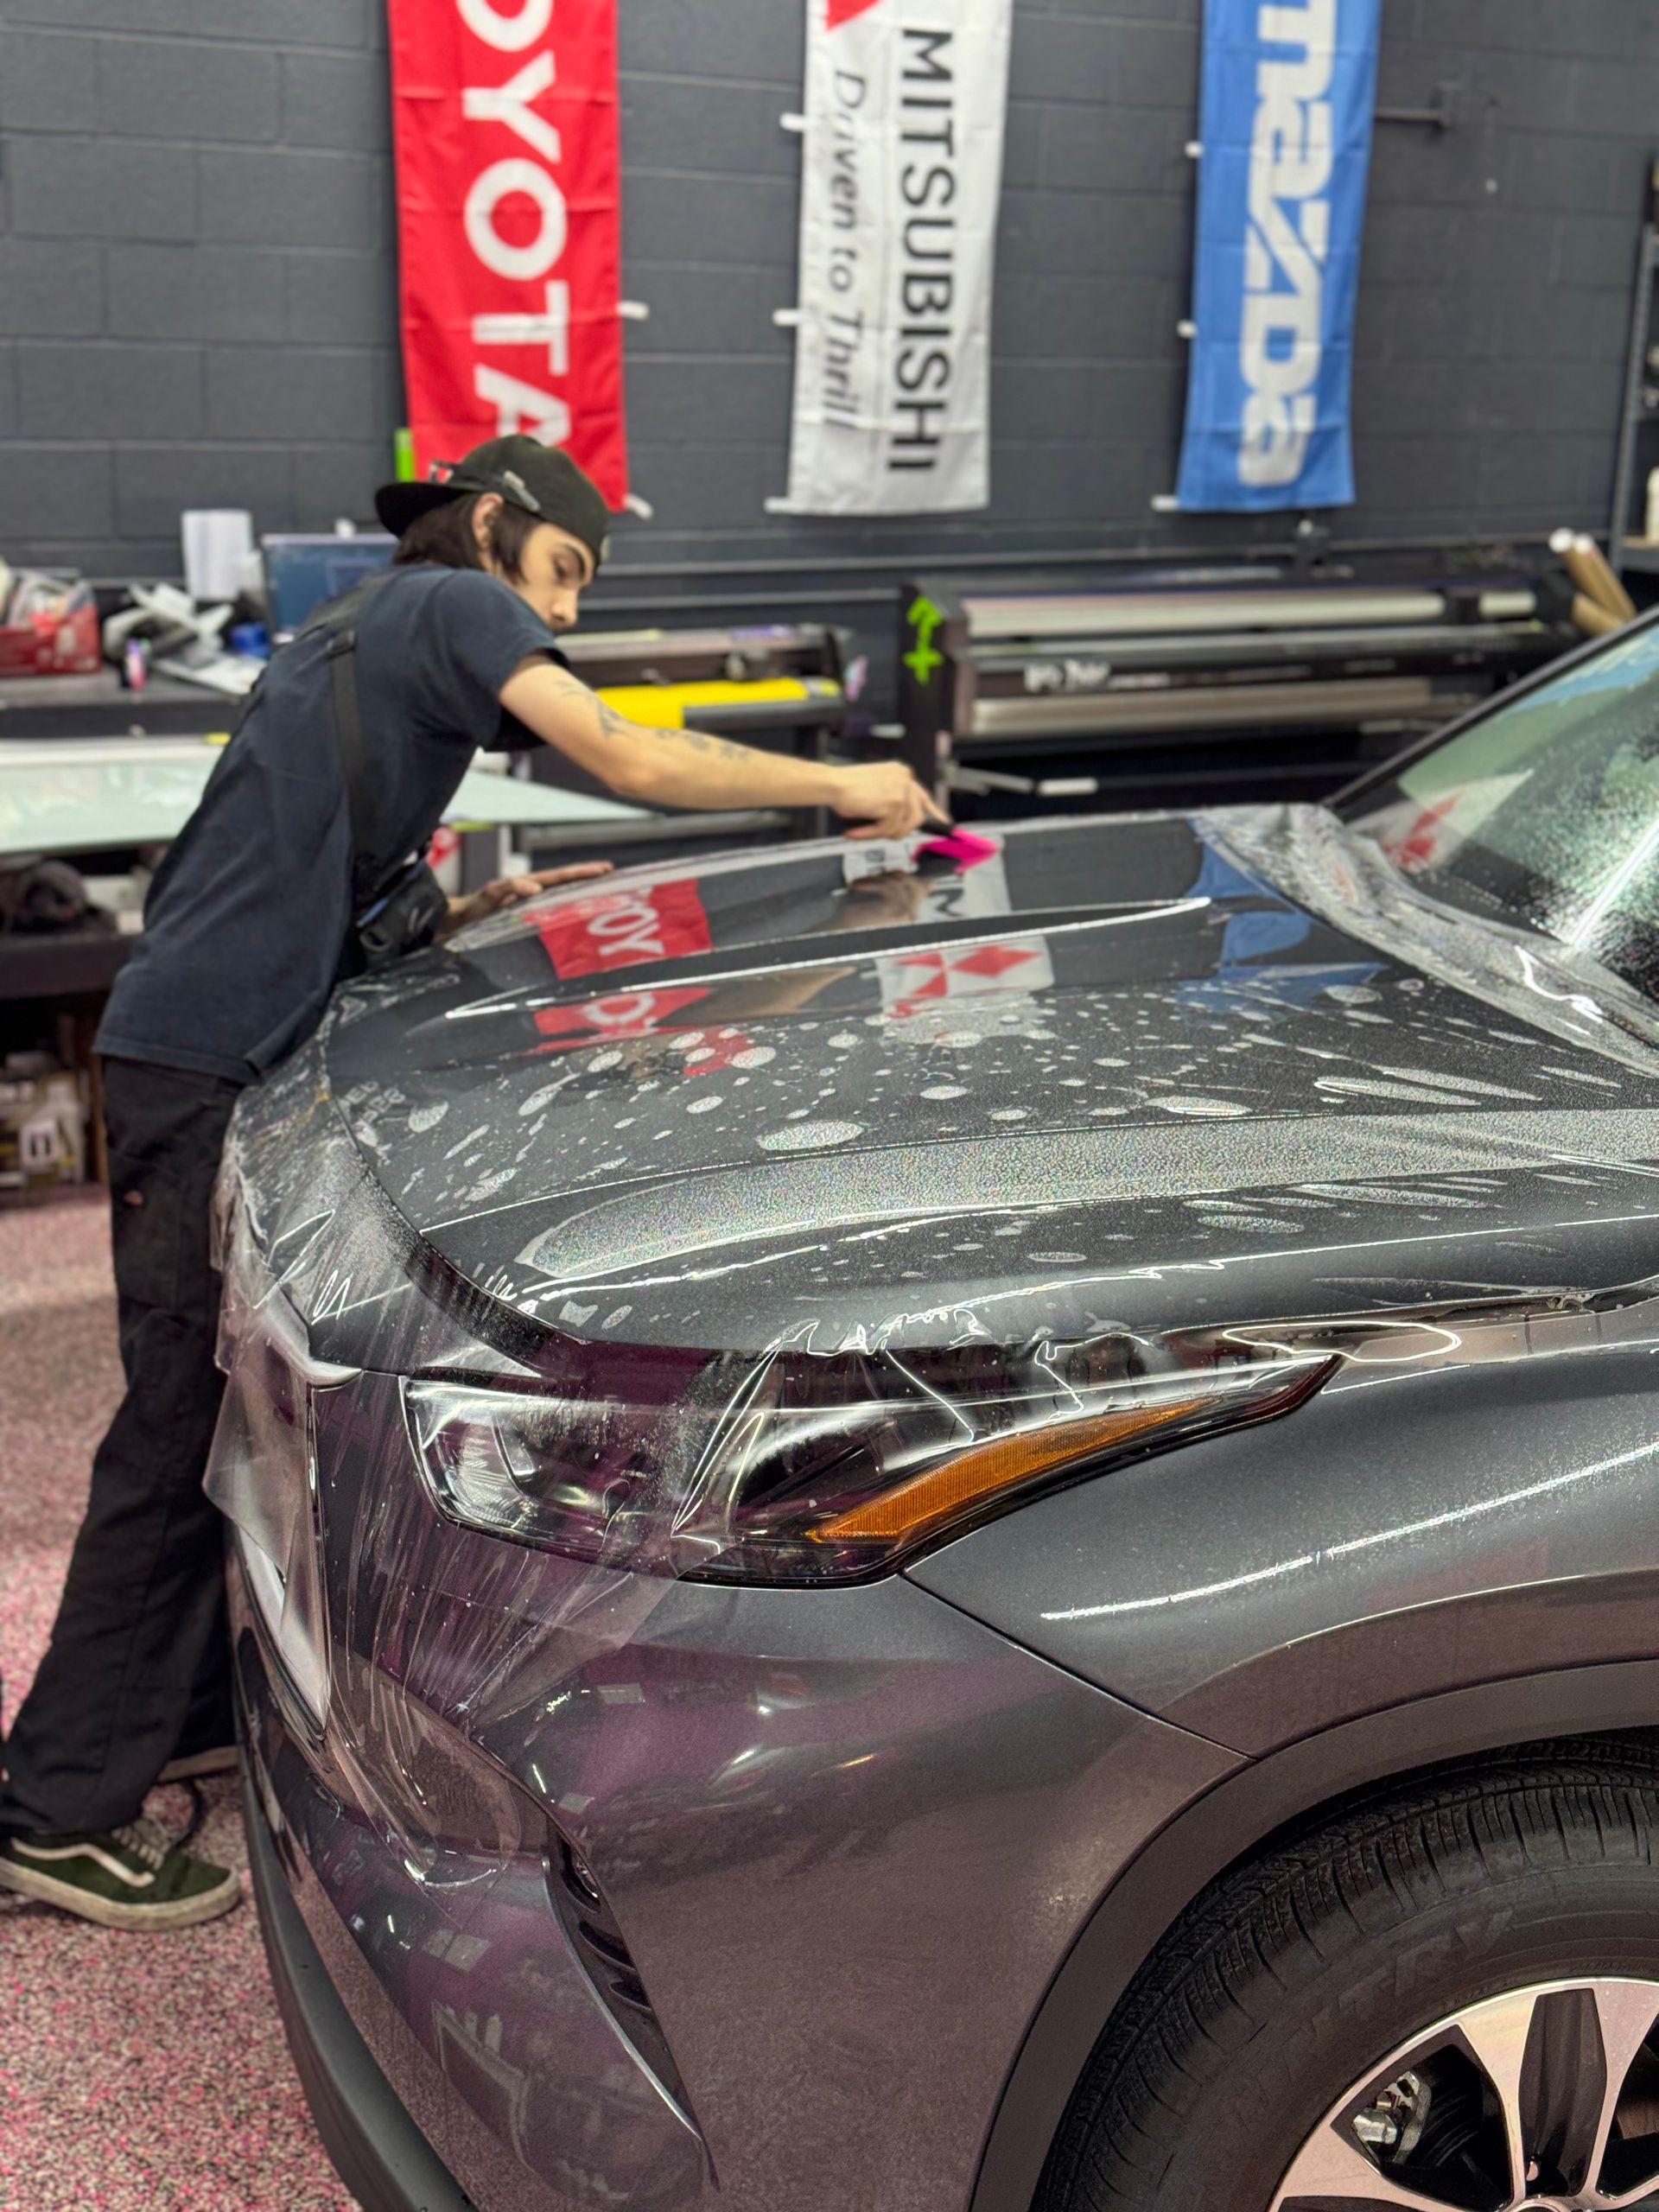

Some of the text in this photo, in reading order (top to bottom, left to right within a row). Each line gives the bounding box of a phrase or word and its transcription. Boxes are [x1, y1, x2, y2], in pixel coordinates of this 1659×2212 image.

[822, 69, 867, 430] Driven to Thrill
[887, 27, 956, 473] MITSUBISHI
